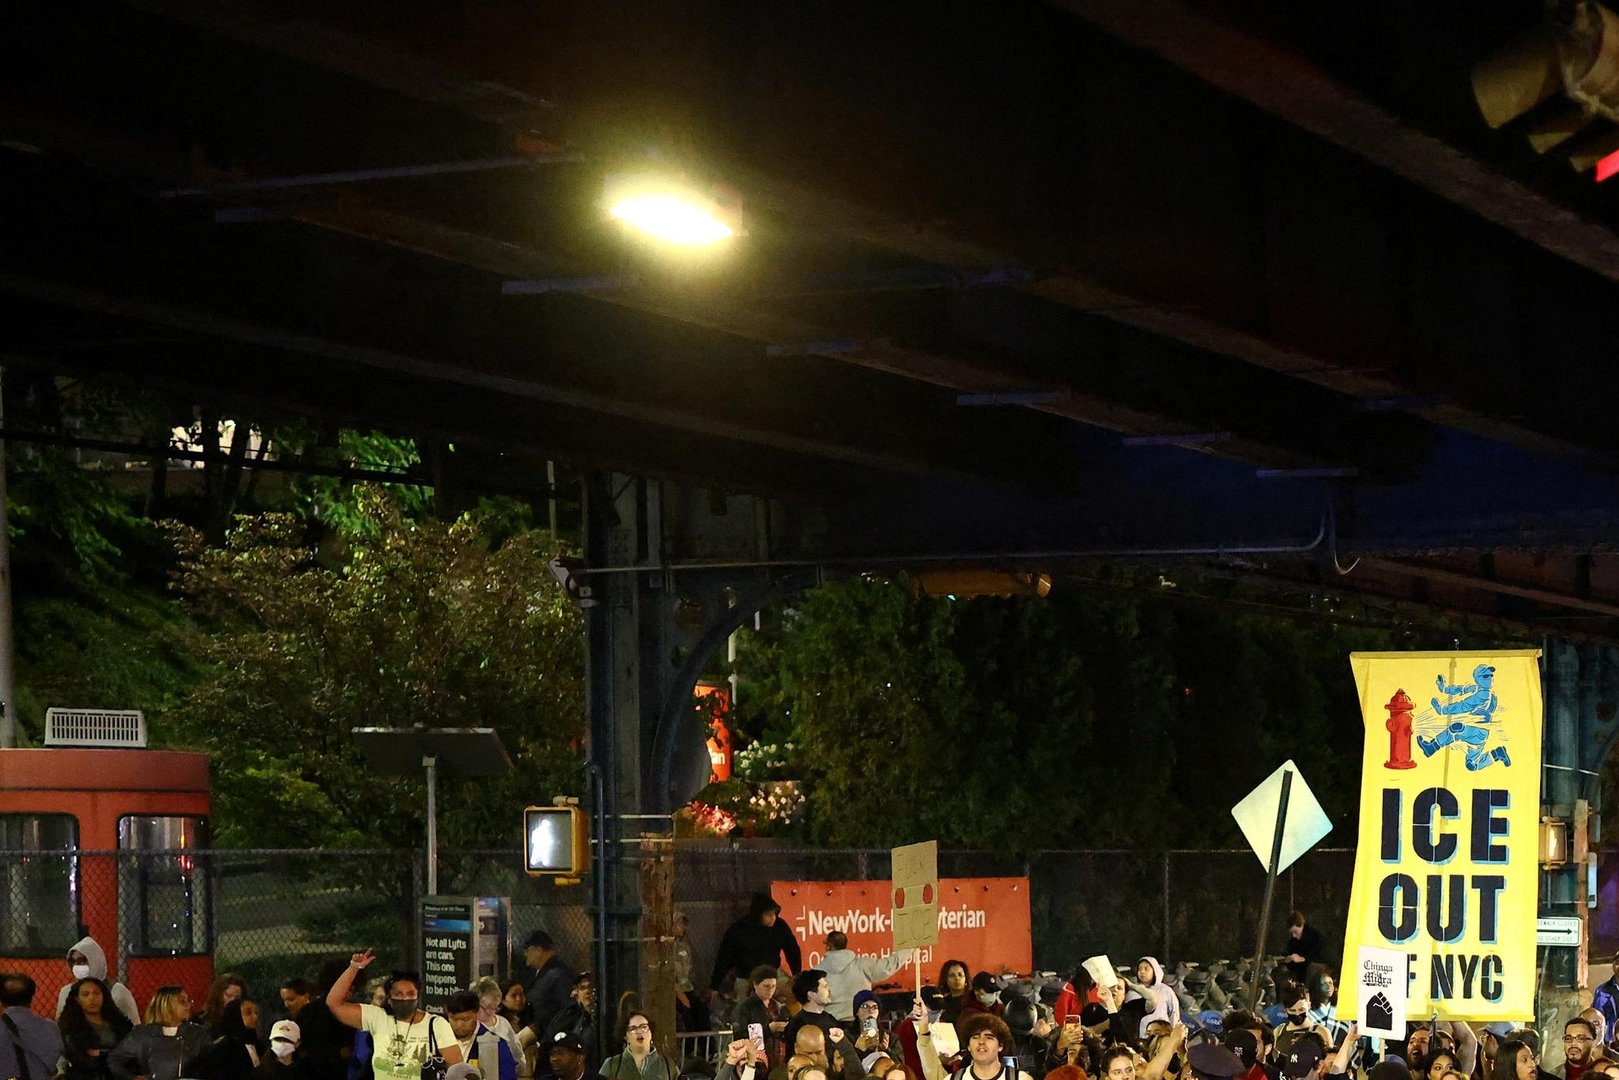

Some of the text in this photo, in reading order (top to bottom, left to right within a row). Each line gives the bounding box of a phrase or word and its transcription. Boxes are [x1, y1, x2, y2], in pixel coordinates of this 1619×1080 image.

[1381, 787, 1511, 865] ICE
[1377, 873, 1506, 943] OUT
[425, 938, 438, 947] Not
[449, 939, 467, 950] Lyfts
[438, 951, 455, 960] cars.
[426, 961, 455, 972] This one
[1363, 960, 1393, 975] Chinga
[426, 973, 456, 984] happens
[1362, 972, 1392, 987] Migra
[1430, 953, 1504, 1002] NYC
[426, 986, 434, 994] to
[434, 986, 444, 994] be
